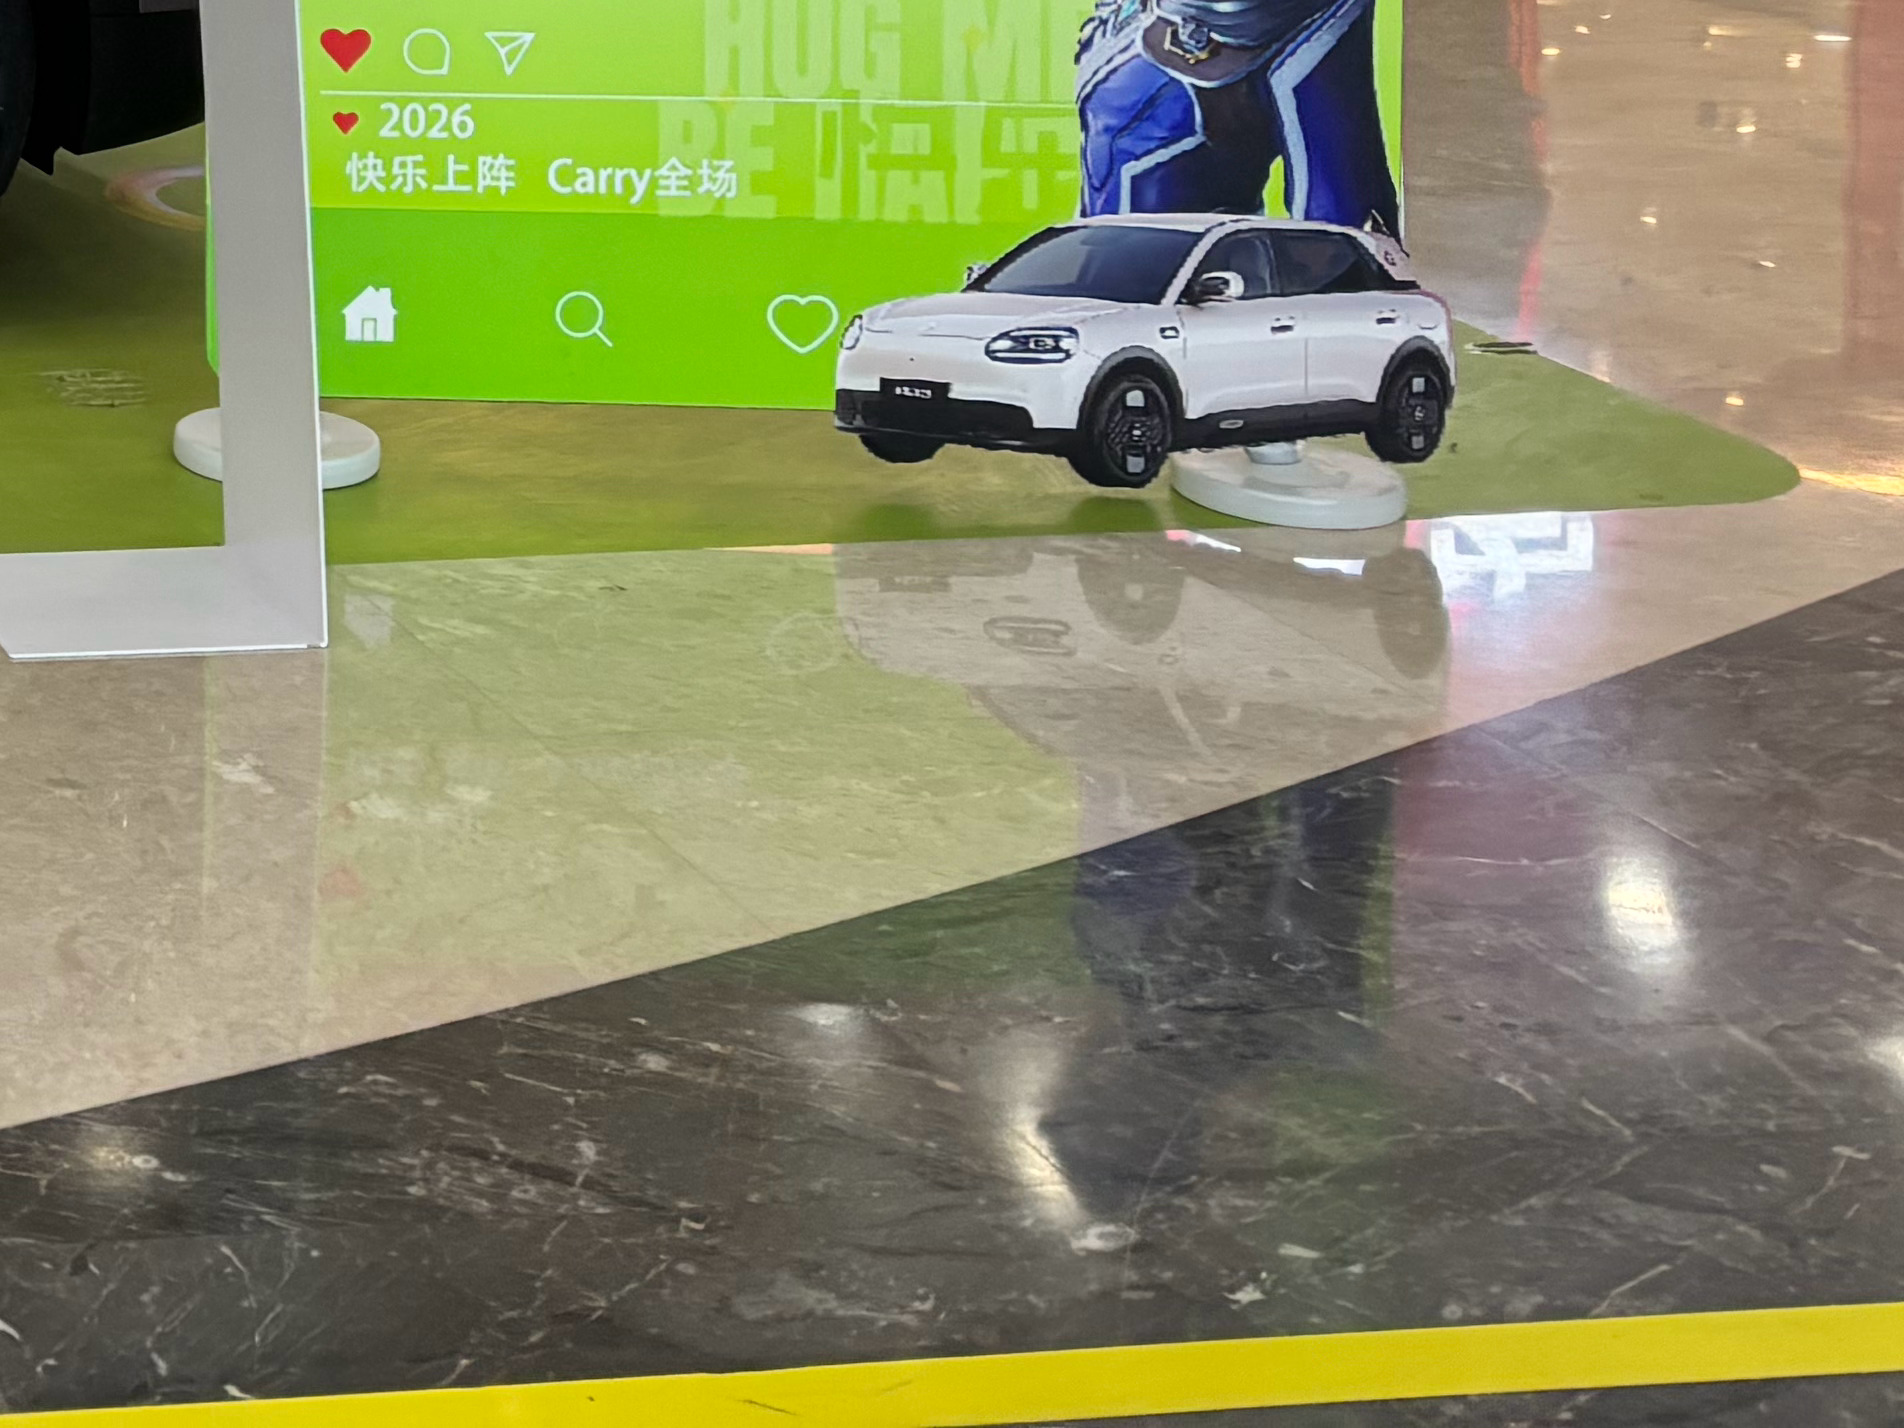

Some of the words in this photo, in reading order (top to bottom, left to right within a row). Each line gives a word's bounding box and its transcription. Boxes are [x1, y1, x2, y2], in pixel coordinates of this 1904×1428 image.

[378, 102, 476, 141] 2026
[346, 150, 517, 196] 快乐上阵
